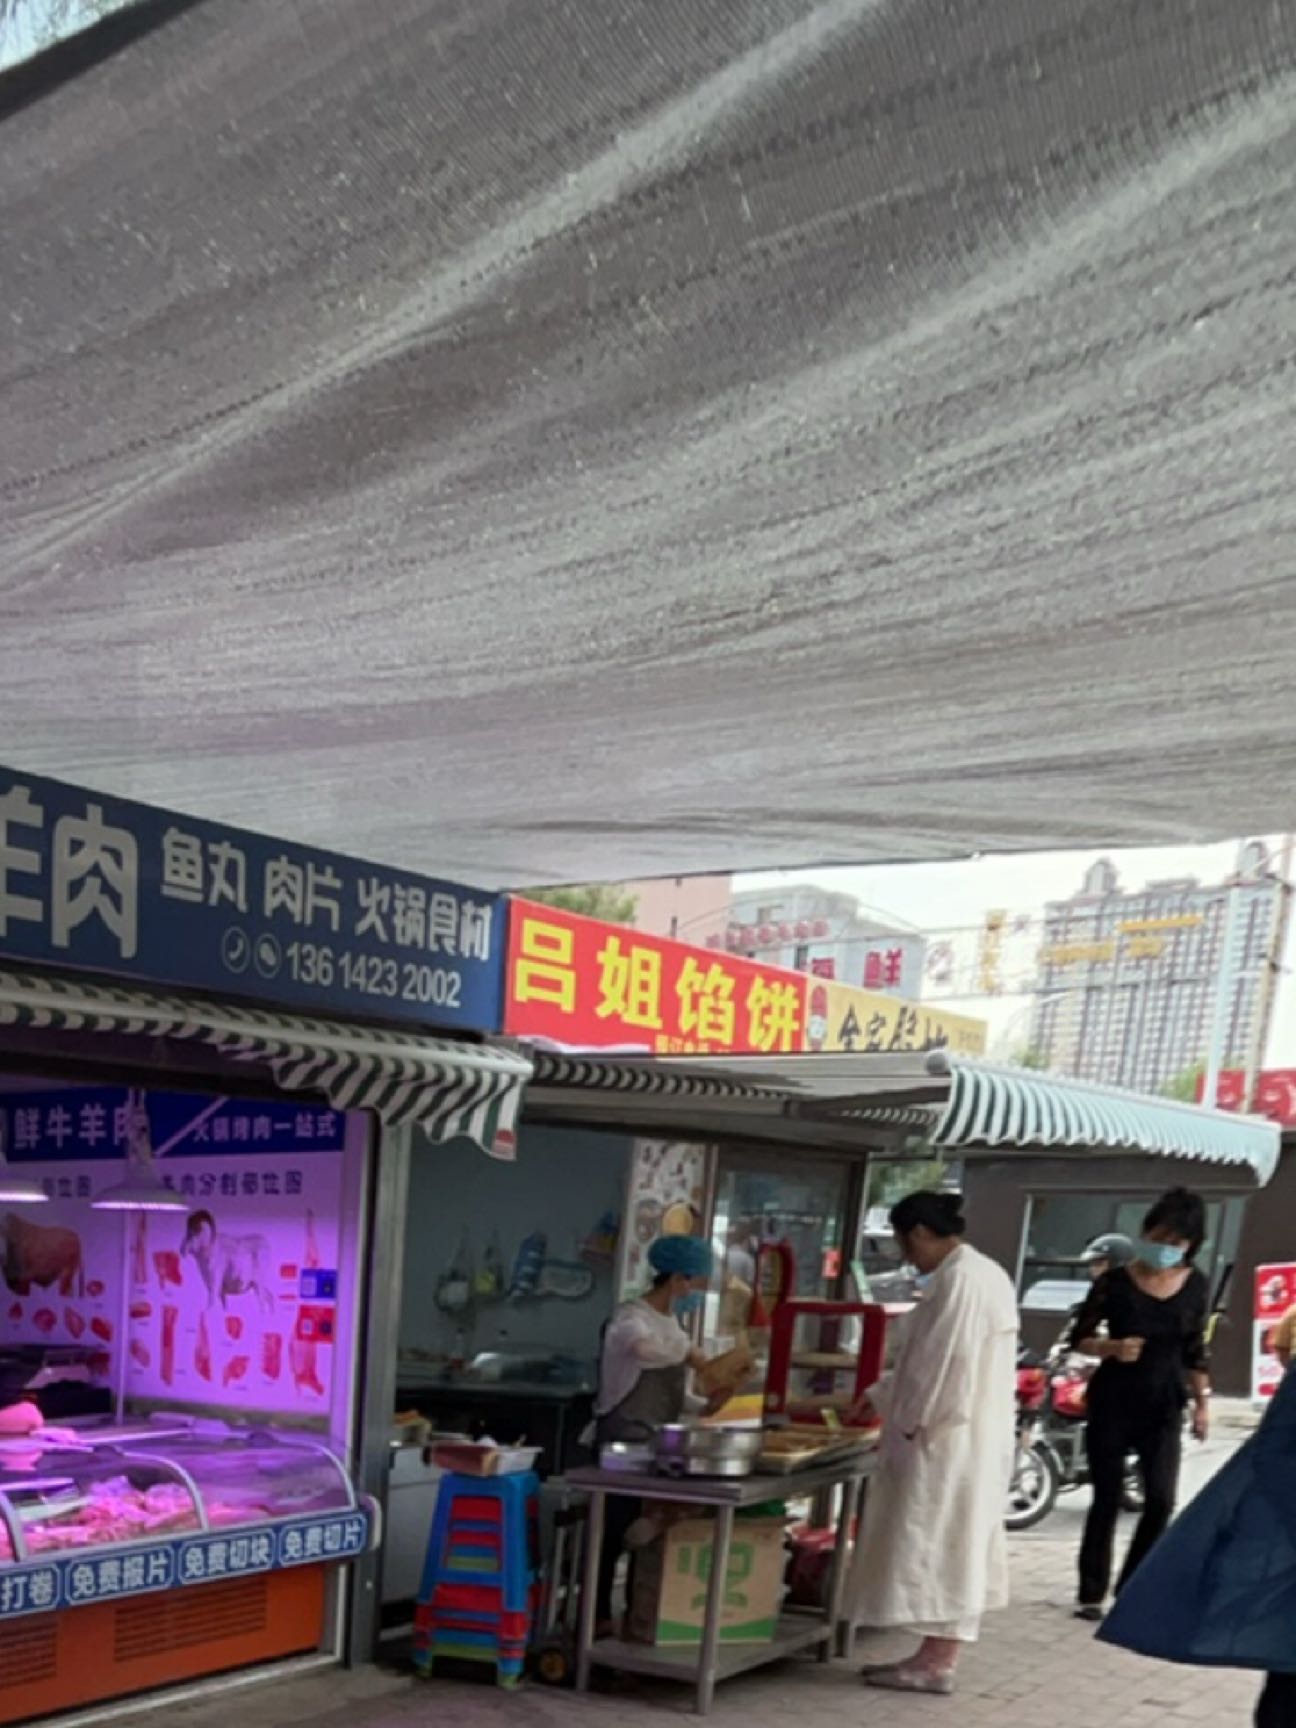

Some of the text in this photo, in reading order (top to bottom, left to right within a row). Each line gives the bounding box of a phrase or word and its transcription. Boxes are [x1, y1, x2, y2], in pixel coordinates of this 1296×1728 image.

[161, 826, 490, 962] 鱼丸 肉片 火锅食材
[286, 941, 460, 1009] 136 1423 2002
[515, 918, 801, 1053] 吕姐馅饼
